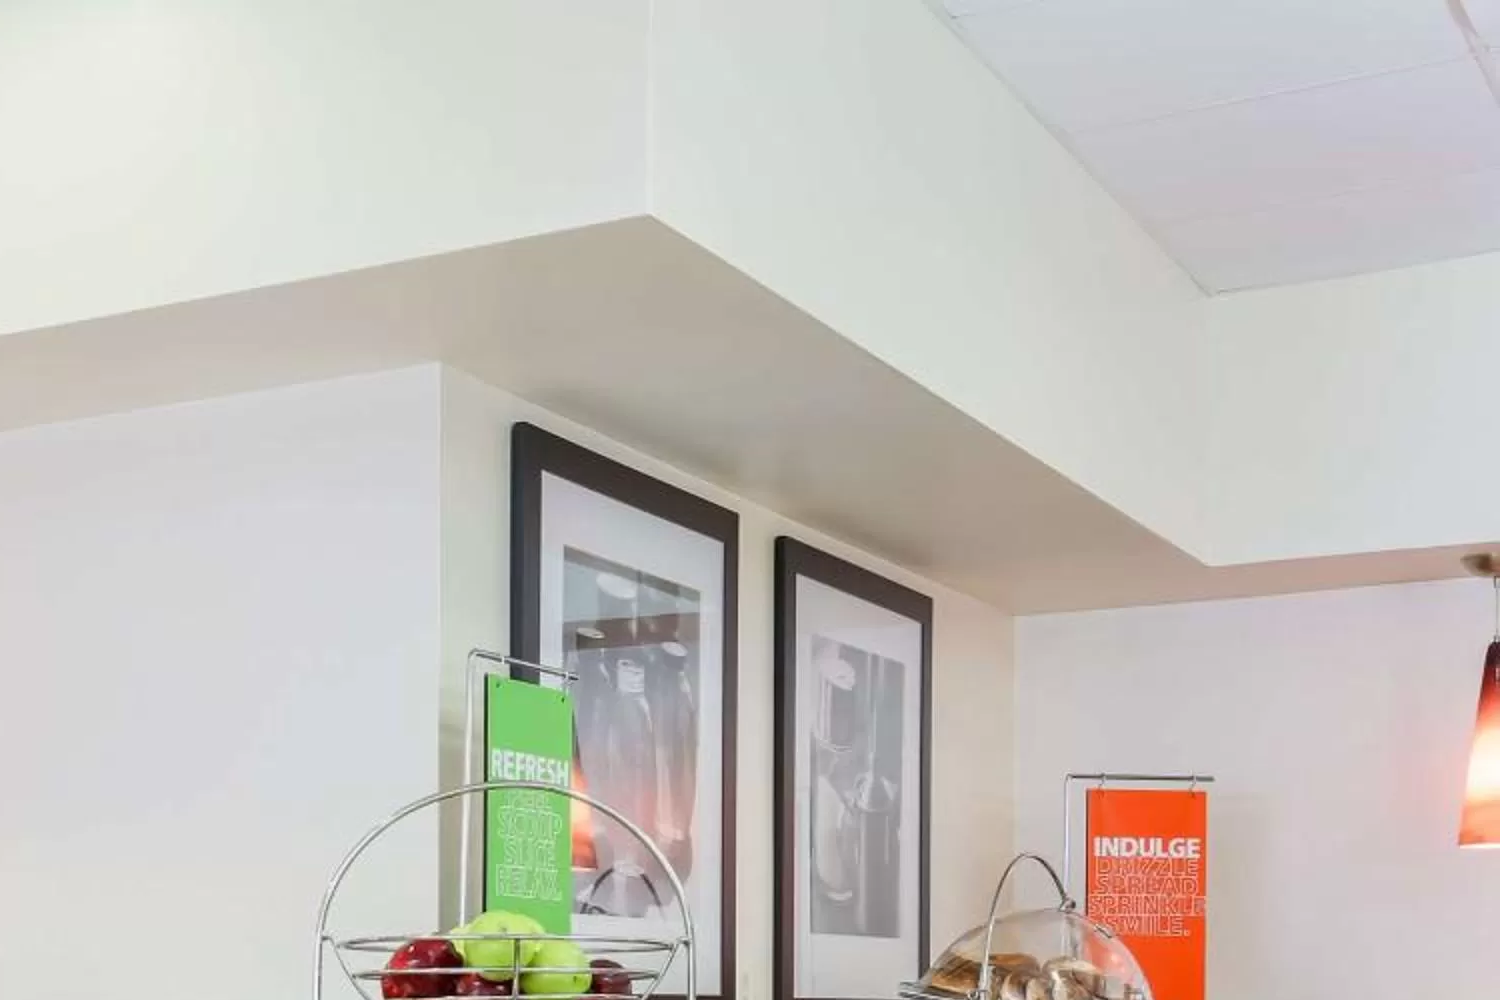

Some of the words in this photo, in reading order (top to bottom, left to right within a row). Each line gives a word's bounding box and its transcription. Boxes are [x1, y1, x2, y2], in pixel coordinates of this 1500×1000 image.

[490, 748, 569, 787] REFRESH
[1093, 837, 1201, 858] INDULGE
[1095, 857, 1199, 877] DRIZZLE
[1094, 874, 1199, 896] SPREAD
